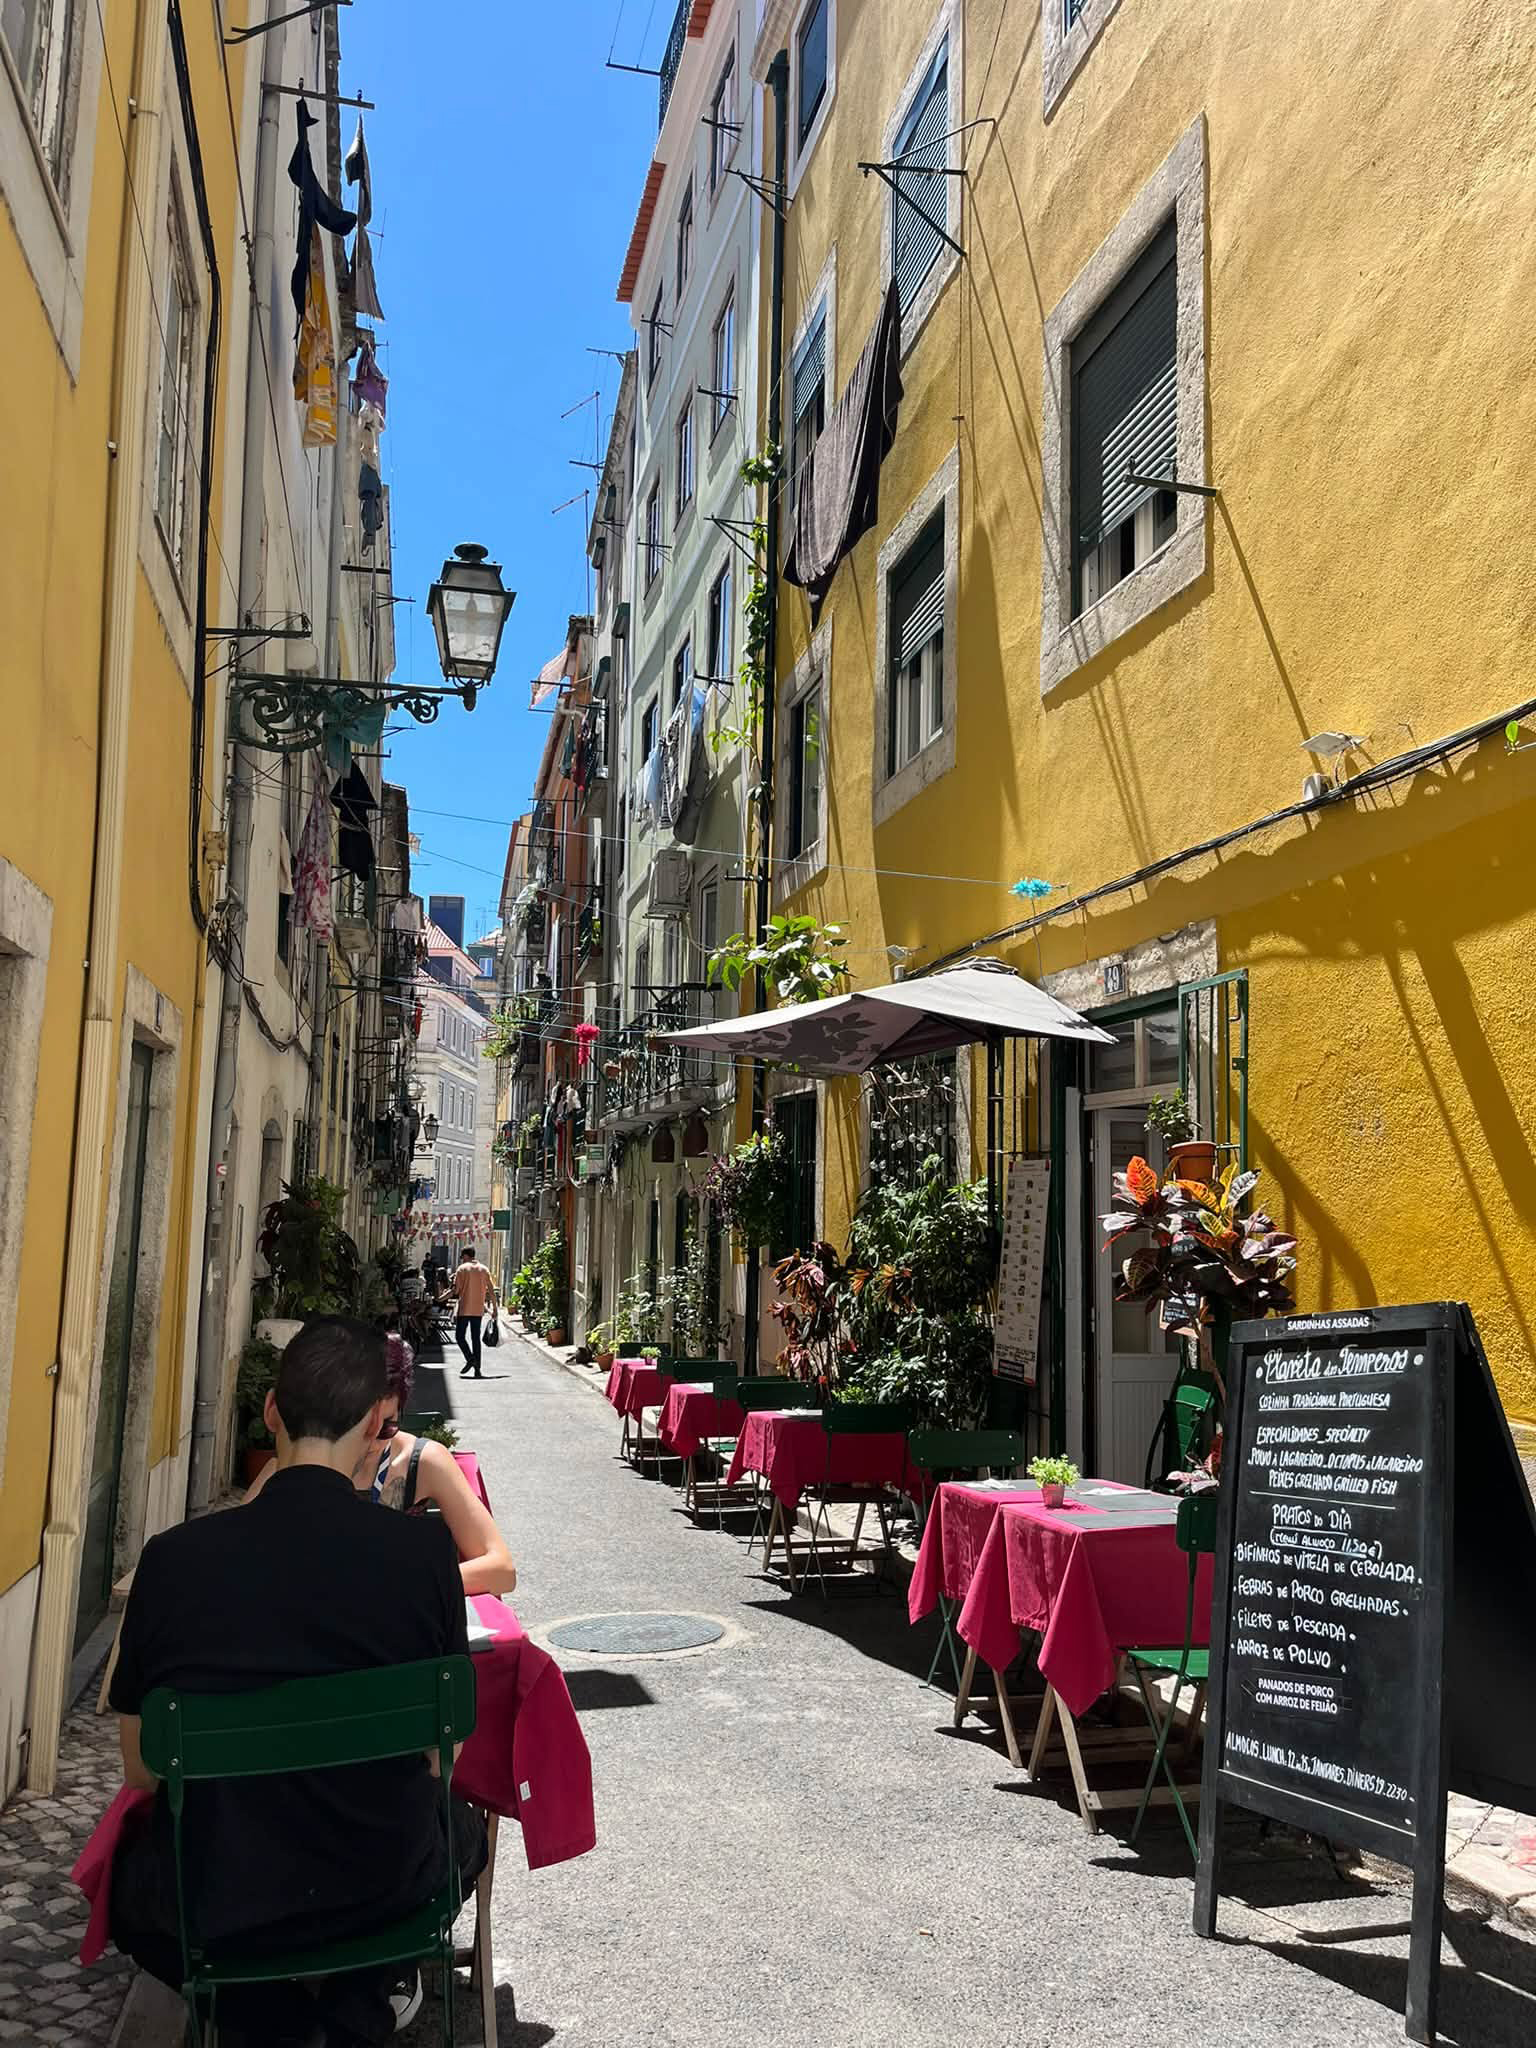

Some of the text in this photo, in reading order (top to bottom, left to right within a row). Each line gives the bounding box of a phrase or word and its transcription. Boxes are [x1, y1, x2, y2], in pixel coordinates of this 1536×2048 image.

[1108, 966, 1119, 992] 49
[1288, 1317, 1369, 1330] SARDINHAS ASSADAS
[1272, 1504, 1312, 1525] PRATOS
[1334, 1563, 1345, 1573] DE
[1277, 1586, 1288, 1598] DE
[1291, 1579, 1324, 1604] PORCO
[1277, 1620, 1289, 1631] DE
[1237, 1638, 1331, 1668] ARROZ DE POLVO
[1258, 1678, 1334, 1698] PANADOS DE PORCO
[1256, 1692, 1337, 1714] COM ARROZ DE FEIJÃO
